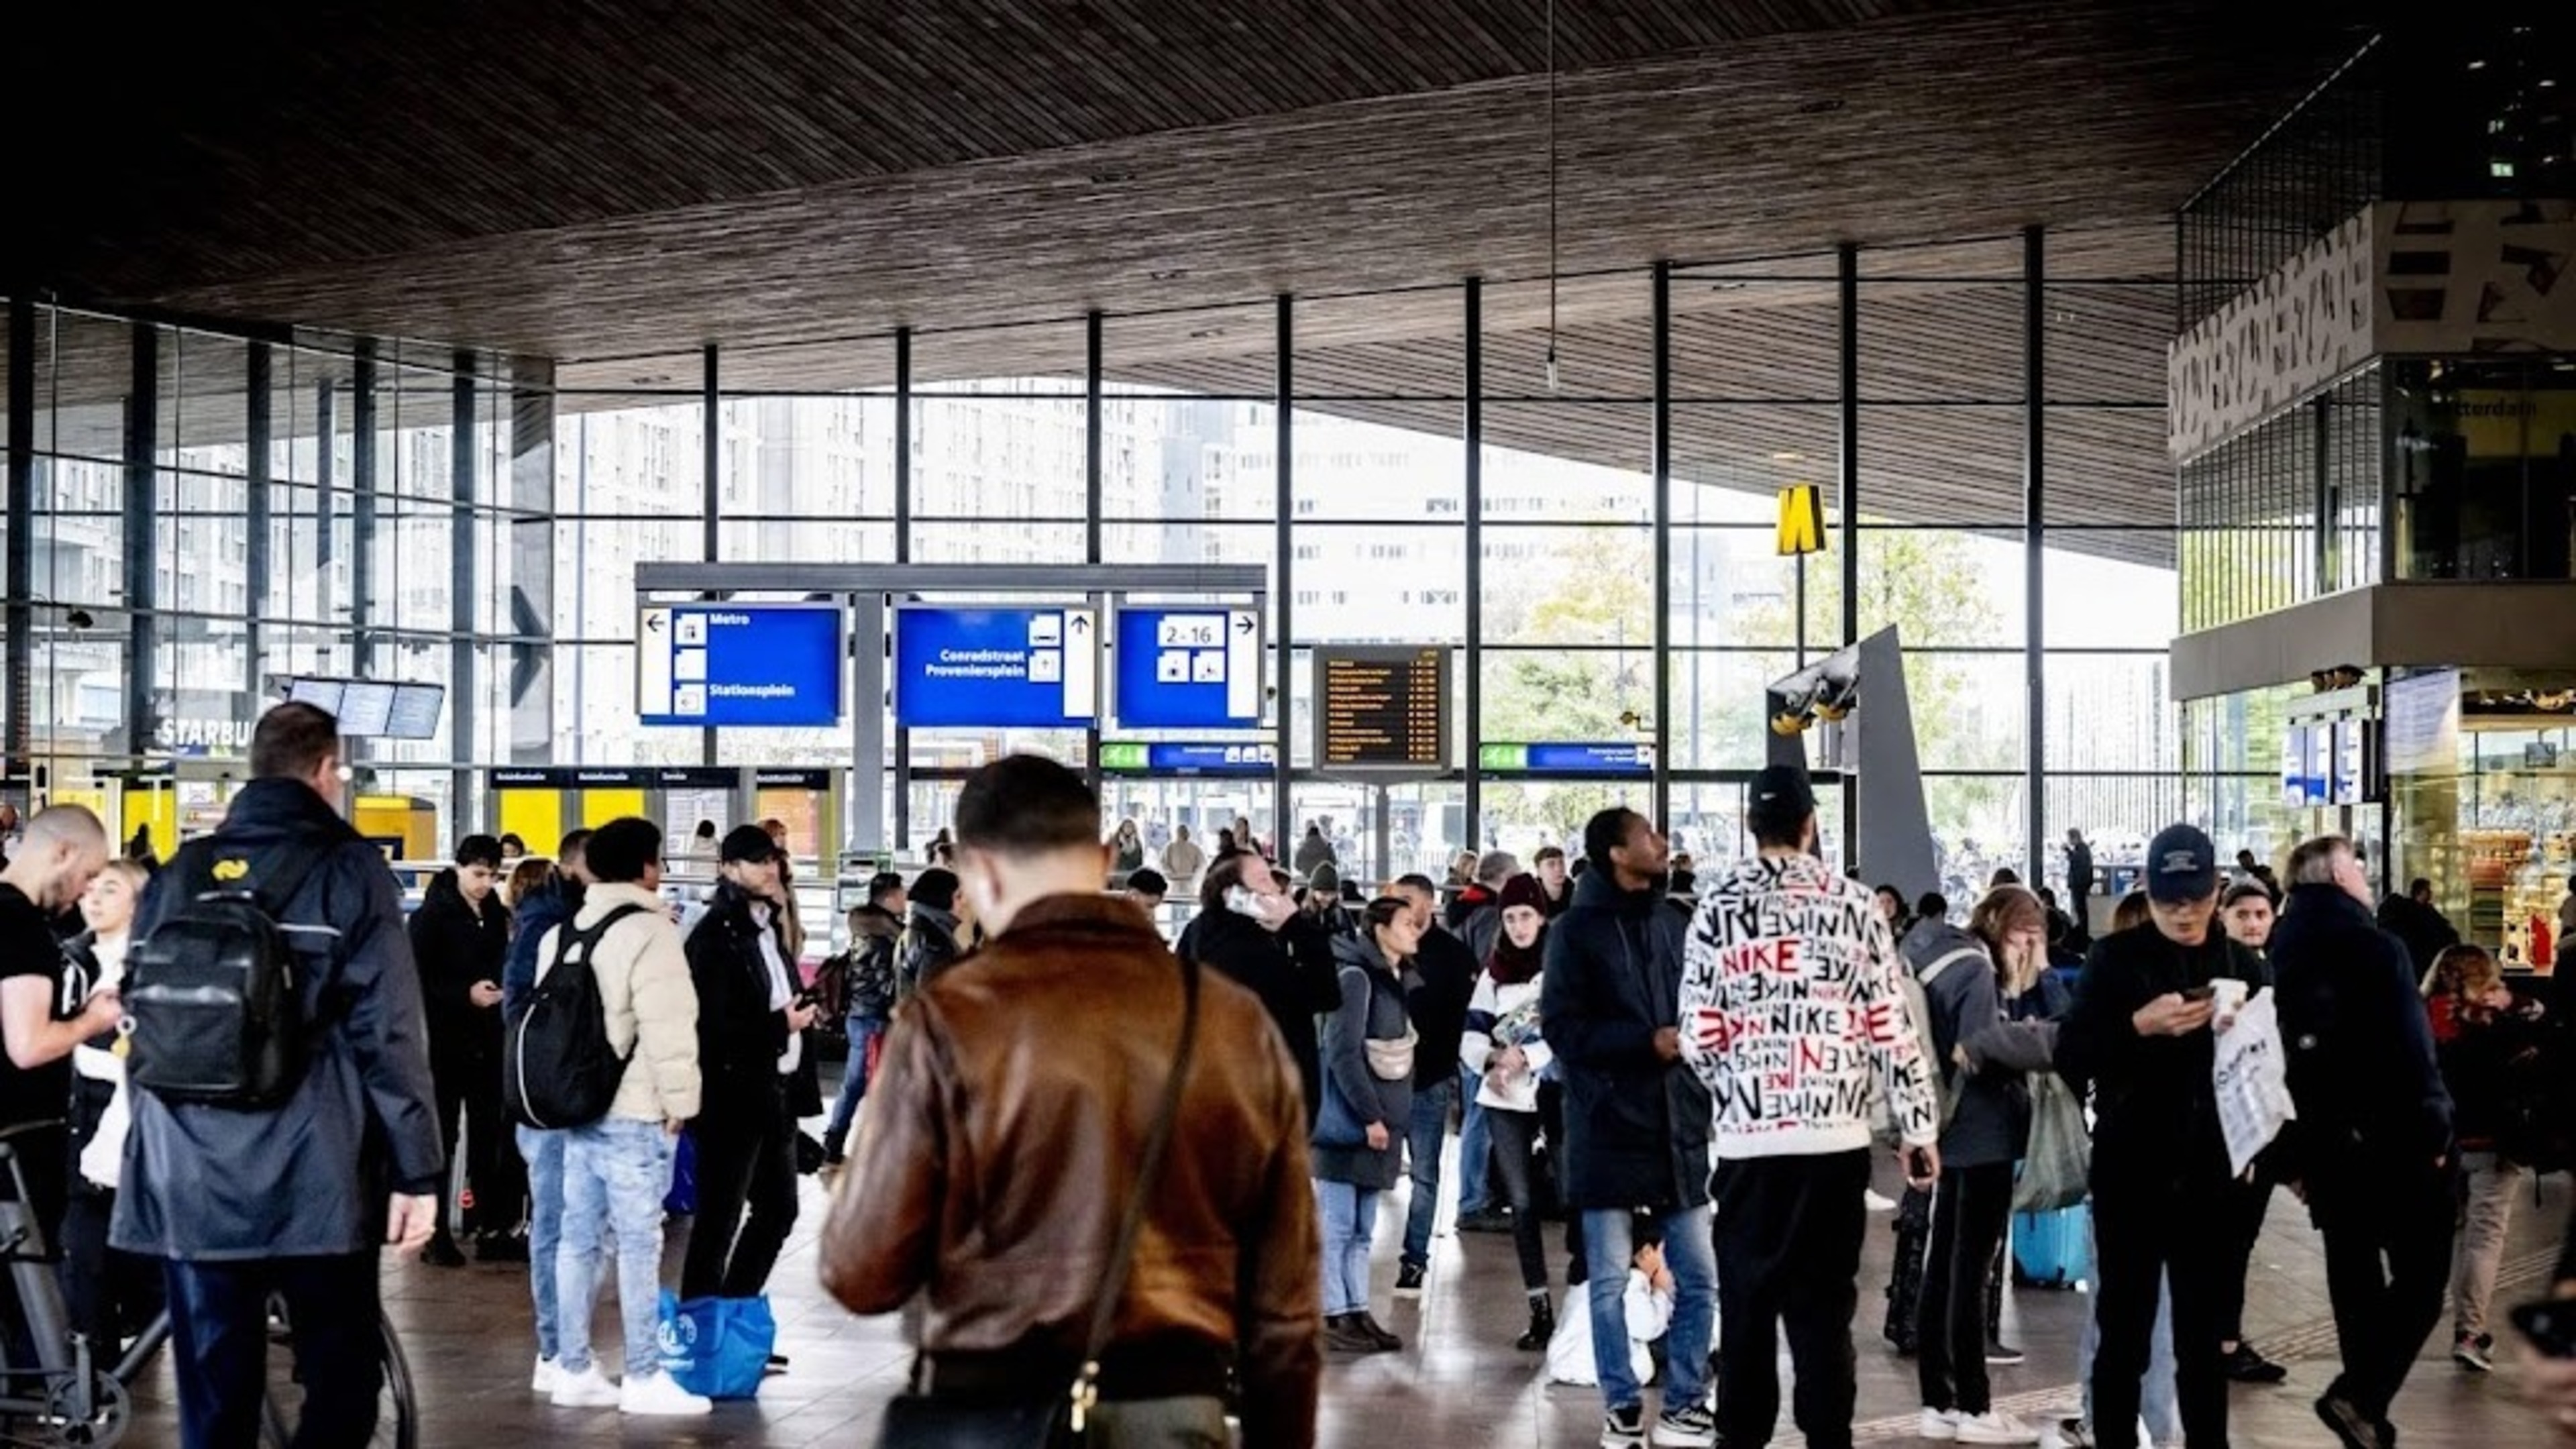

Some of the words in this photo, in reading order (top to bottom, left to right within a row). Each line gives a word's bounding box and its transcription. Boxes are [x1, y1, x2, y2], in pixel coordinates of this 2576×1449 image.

[709, 613, 750, 625] Metro
[709, 684, 796, 698] Stationsplein
[160, 718, 256, 747] STARBU
[1723, 940, 1801, 977] NIKE
[1771, 1003, 1840, 1035] NIKE
